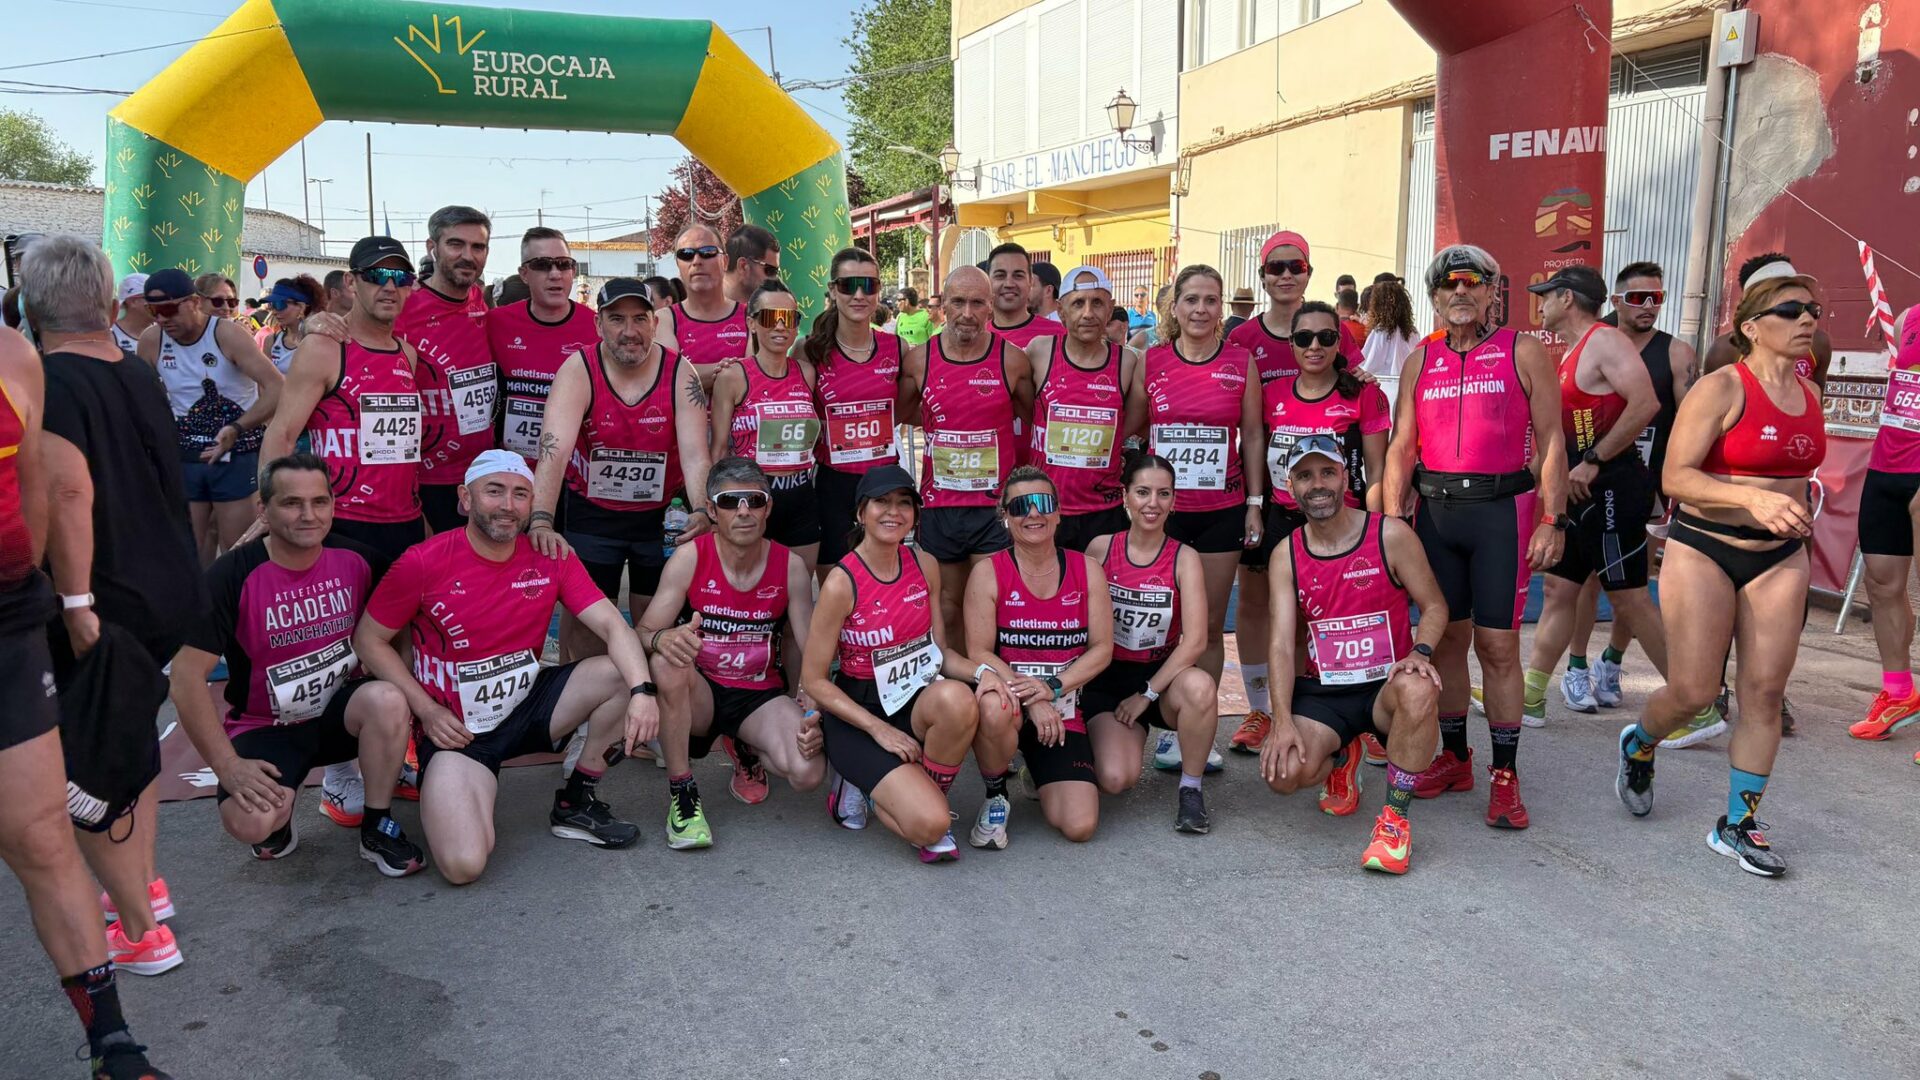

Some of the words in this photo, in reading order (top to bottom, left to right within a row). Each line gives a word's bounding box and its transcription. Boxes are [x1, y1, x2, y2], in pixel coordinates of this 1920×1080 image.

[472, 50, 615, 79] EUROCAJA
[473, 75, 567, 100] RURAL
[991, 162, 1016, 194] BAR
[1025, 156, 1043, 188] EL
[1050, 133, 1137, 182] MANCHEGO
[1543, 258, 1585, 269] PROYECTO
[452, 366, 494, 384] SOLISS
[511, 368, 556, 380] atletismo
[1261, 368, 1299, 379] atletismo
[1422, 380, 1505, 402] MANCHATHON
[364, 396, 417, 407] SOLISS
[763, 404, 814, 415] SOLISS
[832, 402, 888, 416] SOLISS
[1054, 407, 1112, 421] SOLISS
[371, 417, 417, 438] 4425
[781, 423, 807, 441] 66
[844, 420, 880, 440] 560
[1162, 429, 1222, 439] SOLISS
[937, 433, 992, 444] SOLISS
[1061, 427, 1104, 447] 1120
[948, 452, 982, 469] 218
[1166, 448, 1220, 466] 4484
[599, 464, 657, 482] 4430
[1604, 489, 1615, 530] WONG
[1342, 567, 1381, 580] MANCHATHON
[275, 578, 342, 603] ATLETISMO
[1108, 585, 1167, 603] SOLISS
[266, 586, 353, 631] ACADEMY
[702, 604, 749, 619] atletismo
[752, 609, 773, 620] club
[430, 601, 469, 650] CLUB
[1009, 618, 1058, 630] atletismo
[1060, 618, 1081, 629] club
[1113, 607, 1163, 629] 4578
[1316, 616, 1382, 633] SOLISS
[269, 611, 355, 649] MANCHATHON
[999, 631, 1088, 647] MANCHATHON
[1333, 637, 1375, 661] 709
[276, 641, 346, 679] SOLISS
[464, 650, 526, 676] SOLISS
[717, 651, 746, 670] 24
[886, 652, 932, 686] 4475
[474, 671, 531, 705] 4474
